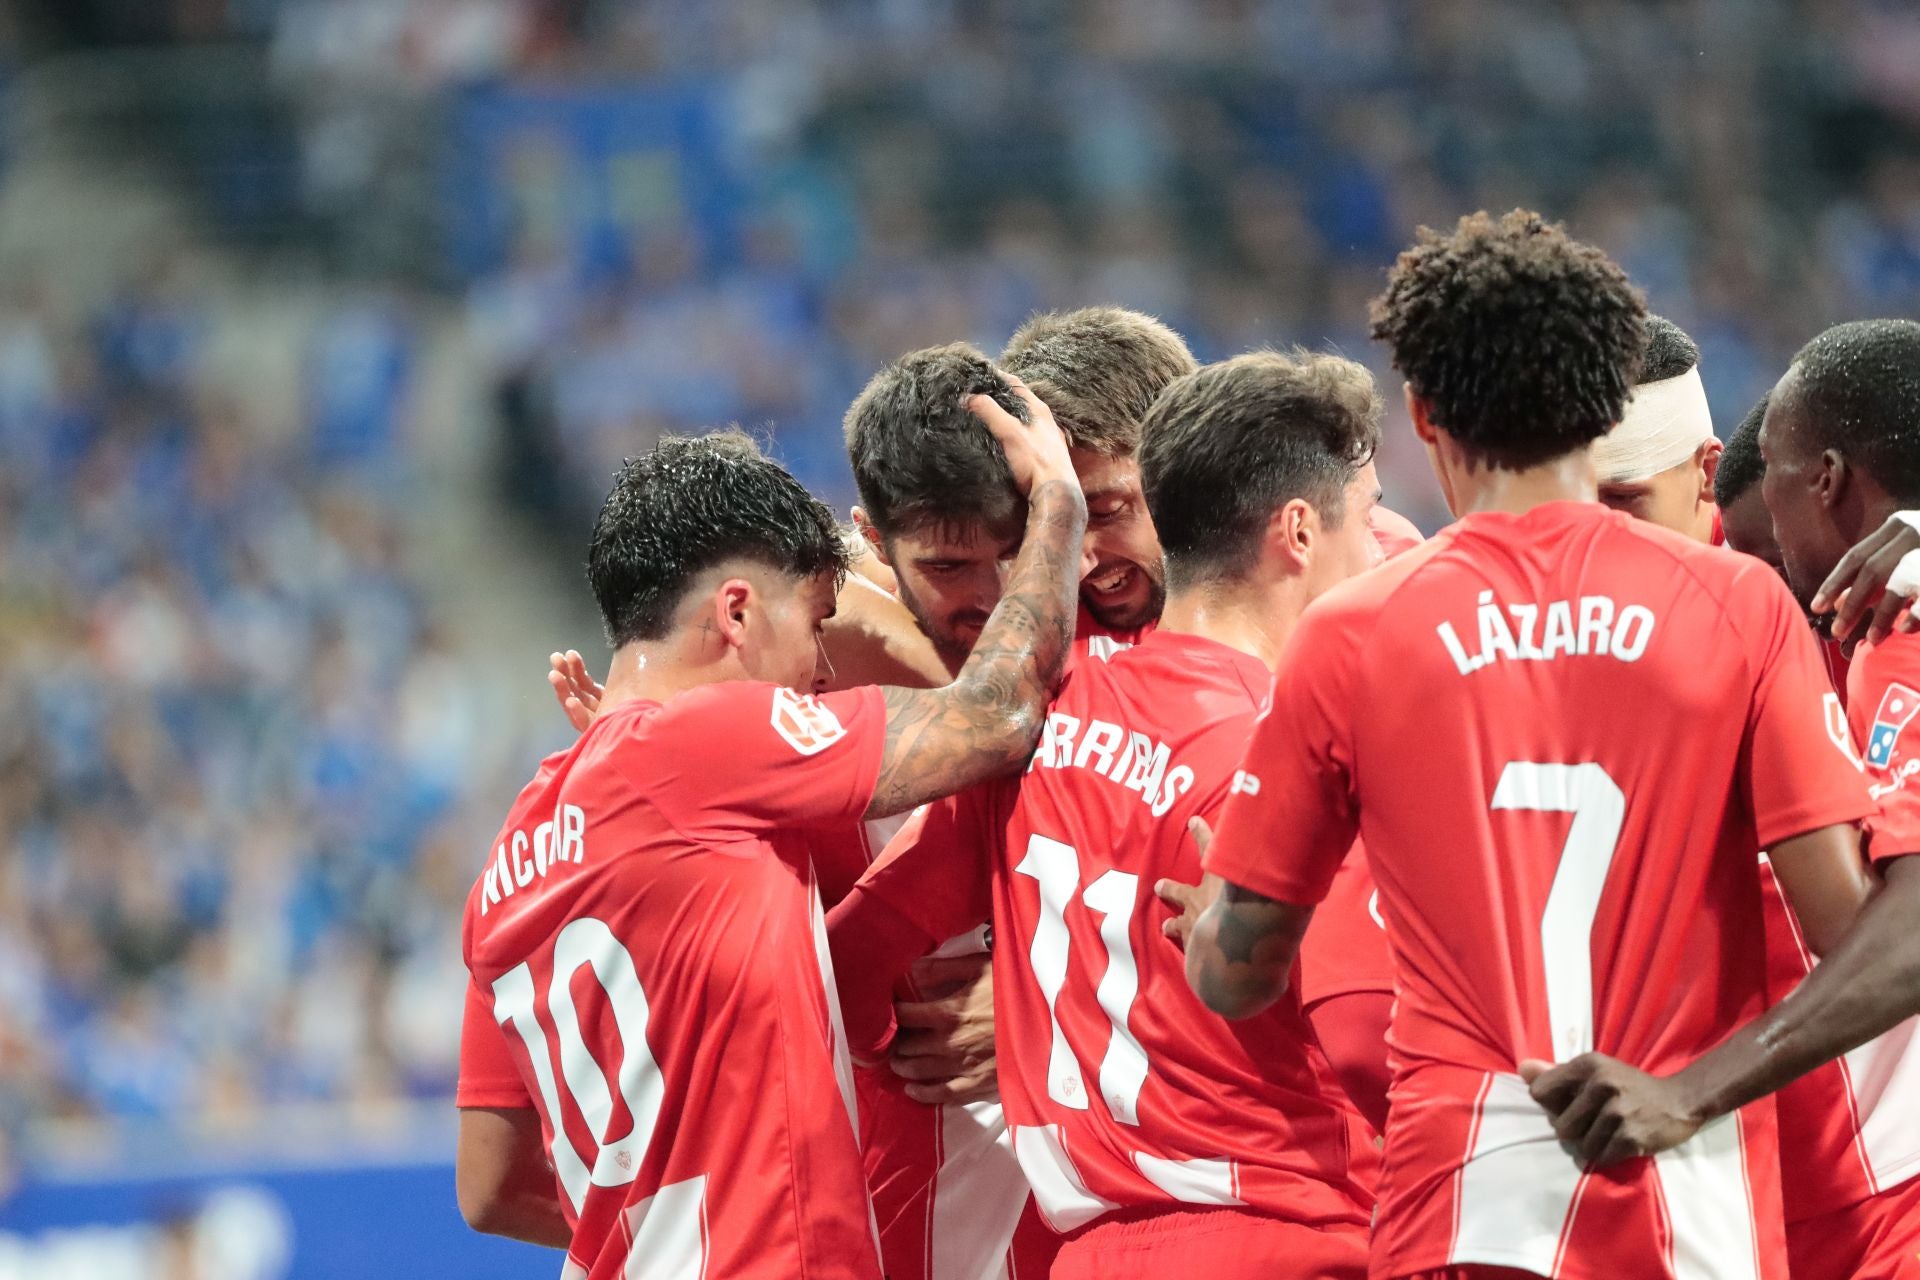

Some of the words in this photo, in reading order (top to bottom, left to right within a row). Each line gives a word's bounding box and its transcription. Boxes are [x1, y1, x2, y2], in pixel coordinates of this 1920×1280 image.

[1436, 590, 1655, 676] LÁZARO
[1015, 834, 1151, 1127] 11
[1491, 761, 1626, 1063] 7
[491, 917, 665, 1217] 10
